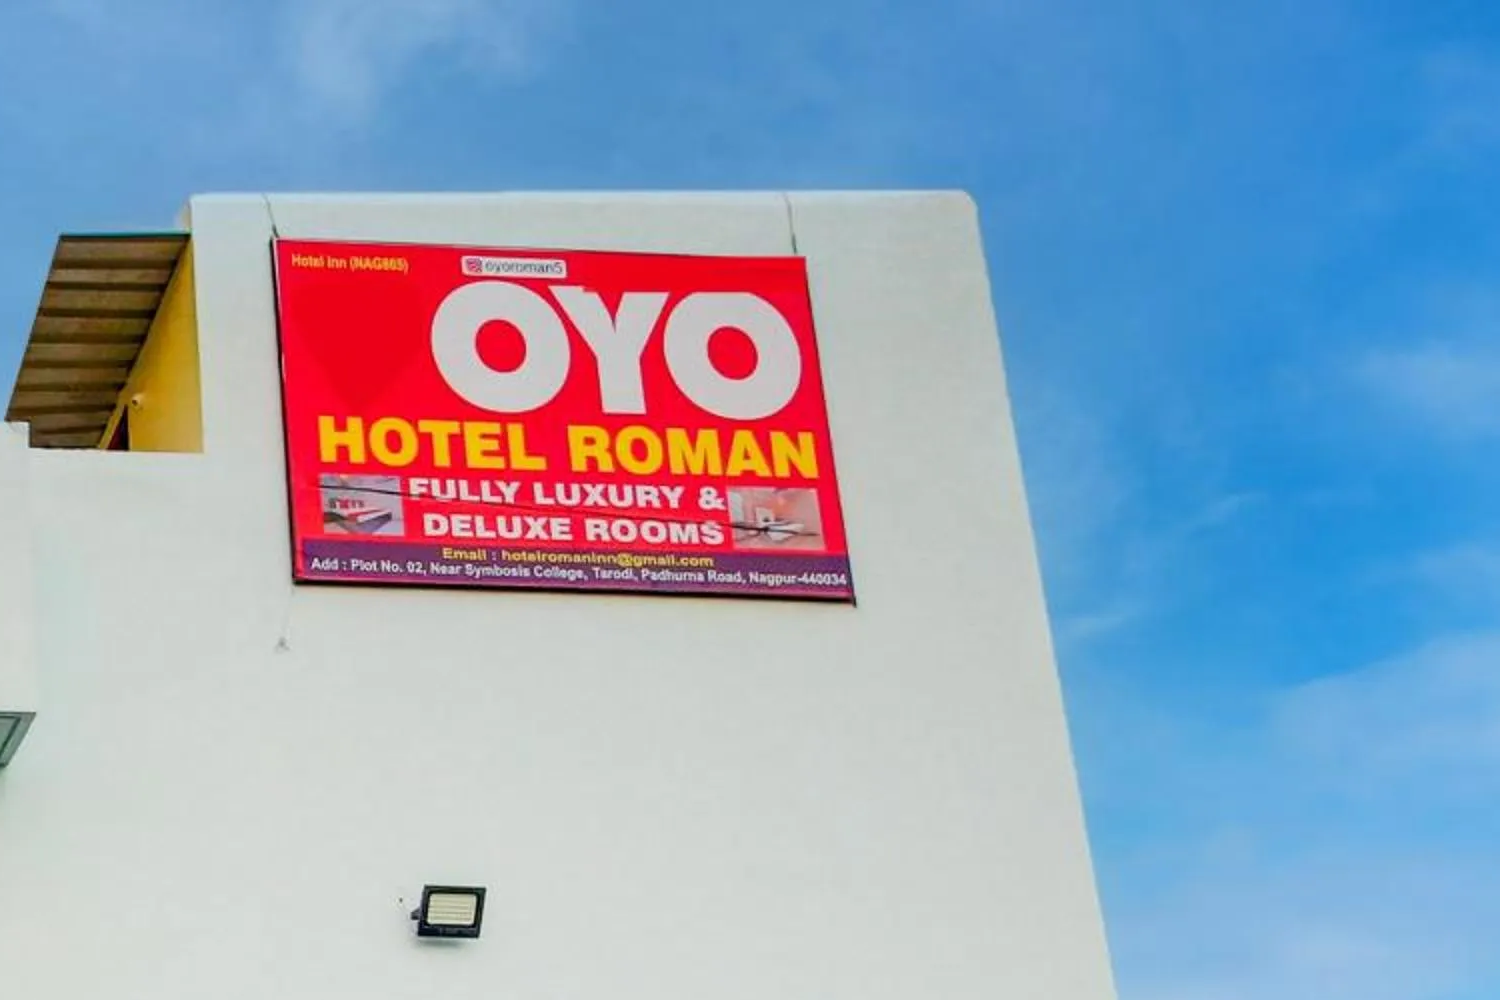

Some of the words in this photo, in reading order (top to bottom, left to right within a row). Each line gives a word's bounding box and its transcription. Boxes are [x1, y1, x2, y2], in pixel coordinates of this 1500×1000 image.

[291, 253, 325, 268] Hotel
[327, 256, 347, 269] Inn
[431, 281, 801, 420] OYO
[318, 415, 547, 471] HOTEL
[567, 425, 819, 478] ROMAN
[408, 477, 521, 504] FULLY
[532, 482, 684, 509] LUXURY
[698, 487, 727, 510] &
[423, 513, 573, 541] DELUXE
[585, 518, 725, 545] ROOMS
[311, 558, 339, 571] Add
[351, 558, 378, 572] Plot
[381, 560, 403, 573] No.
[407, 561, 427, 576] 02,
[430, 562, 462, 576] Near
[534, 565, 588, 581] College,
[707, 570, 746, 584] Road,
[443, 547, 488, 560] Email
[501, 549, 714, 568] hotelromaninn@gmail.com
